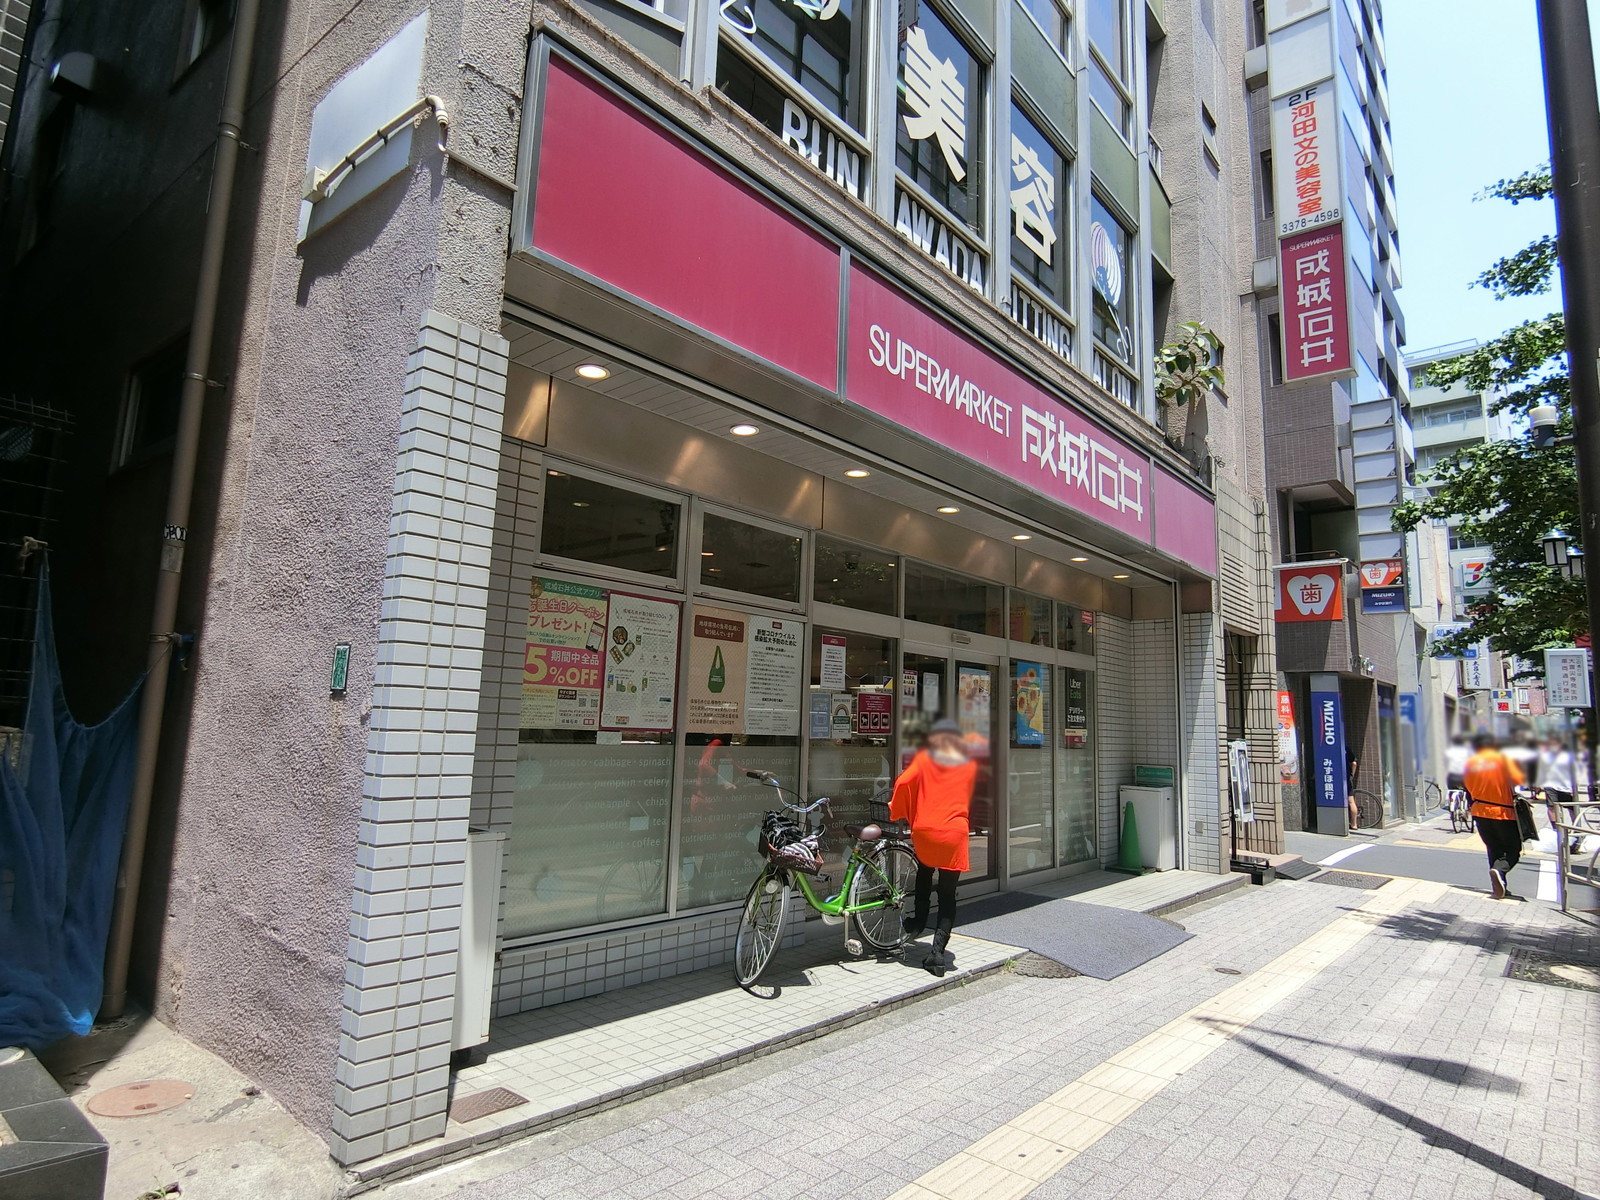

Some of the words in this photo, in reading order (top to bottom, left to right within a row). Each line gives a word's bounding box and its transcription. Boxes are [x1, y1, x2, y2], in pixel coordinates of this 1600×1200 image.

[1288, 87, 1318, 107] 2F
[903, 25, 966, 182] 美
[1010, 132, 1057, 266] 容
[1291, 101, 1322, 217] 河田文の美容室
[1282, 209, 1340, 232] 3378-4598
[1289, 234, 1335, 252] SUPERMARKET
[1296, 249, 1335, 368] 成城石井
[868, 324, 1013, 438] SUPERMARKET
[1021, 403, 1144, 522] 成城石井
[544, 582, 600, 597] 成城石井公式アプリ
[1300, 582, 1323, 604] 歯
[551, 650, 599, 665] 期間中全品
[1069, 678, 1081, 689] Uber
[1069, 689, 1081, 699] Eats
[1322, 700, 1336, 745] MIZUHO
[548, 757, 587, 767] tomato
[593, 757, 632, 769] cabbage
[638, 757, 671, 768] spinach
[594, 777, 636, 789] pumpkin
[644, 777, 669, 788] celery
[1322, 758, 1335, 800] みずほ銀行
[645, 798, 669, 809] chips
[652, 817, 667, 826] tea
[631, 836, 661, 848] coffee
